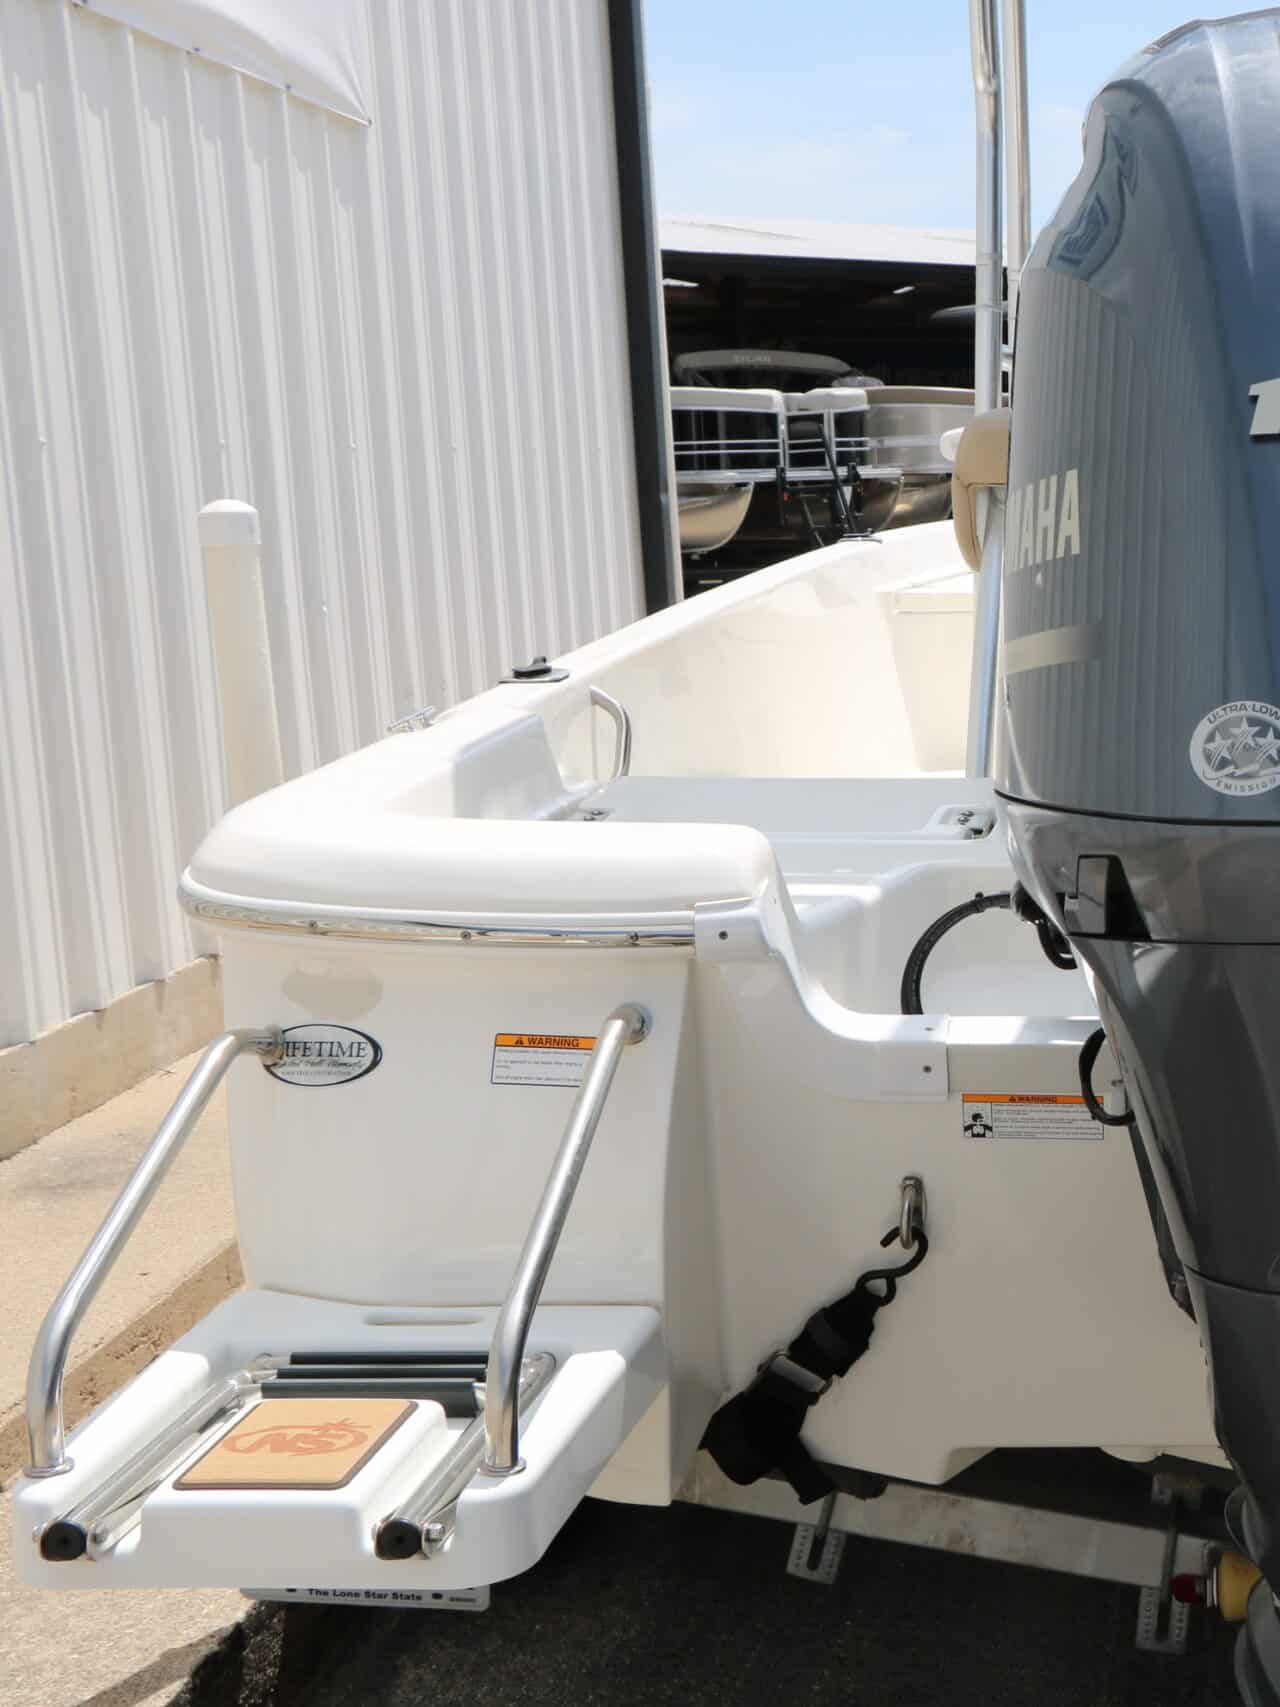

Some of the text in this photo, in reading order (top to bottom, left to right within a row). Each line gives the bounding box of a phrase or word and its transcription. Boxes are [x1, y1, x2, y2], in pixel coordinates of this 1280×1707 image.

[1206, 702, 1249, 725] ULTRA
[284, 1041, 368, 1058] IFETIME
[527, 1037, 580, 1048] WARNING
[308, 1588, 422, 1601] The Lone Star State
